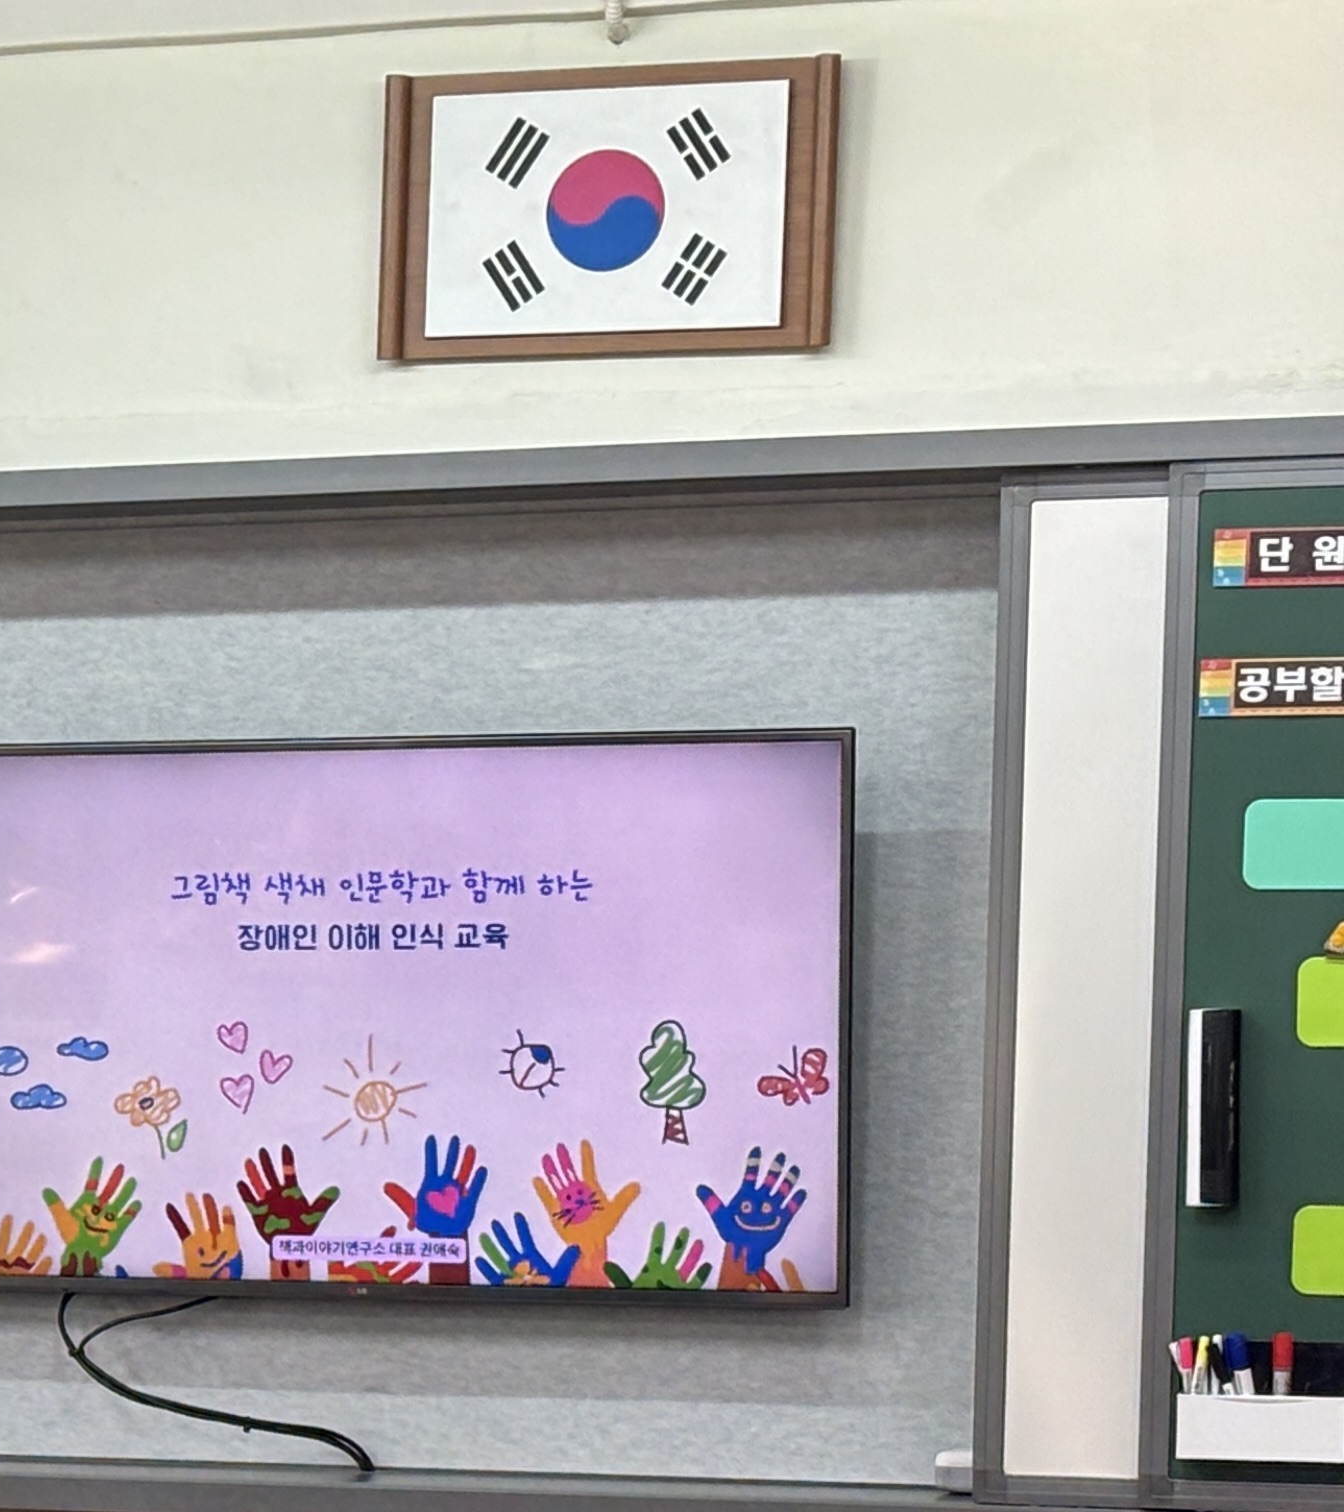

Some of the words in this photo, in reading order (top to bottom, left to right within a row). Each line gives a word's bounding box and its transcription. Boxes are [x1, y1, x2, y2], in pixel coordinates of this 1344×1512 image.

[1258, 536, 1294, 572] 단
[1238, 666, 1344, 703] 공부할
[170, 871, 251, 906] 그림책
[264, 871, 326, 905] 색채
[339, 868, 451, 904] 인문학과
[462, 867, 525, 903] 함께
[537, 868, 594, 901] 하는
[237, 923, 317, 951] 장애인
[327, 922, 381, 950] 이해
[391, 922, 444, 950] 인식
[454, 922, 510, 950] 교육
[279, 1240, 386, 1256] 책과이야기연구소
[390, 1242, 416, 1256] 대표
